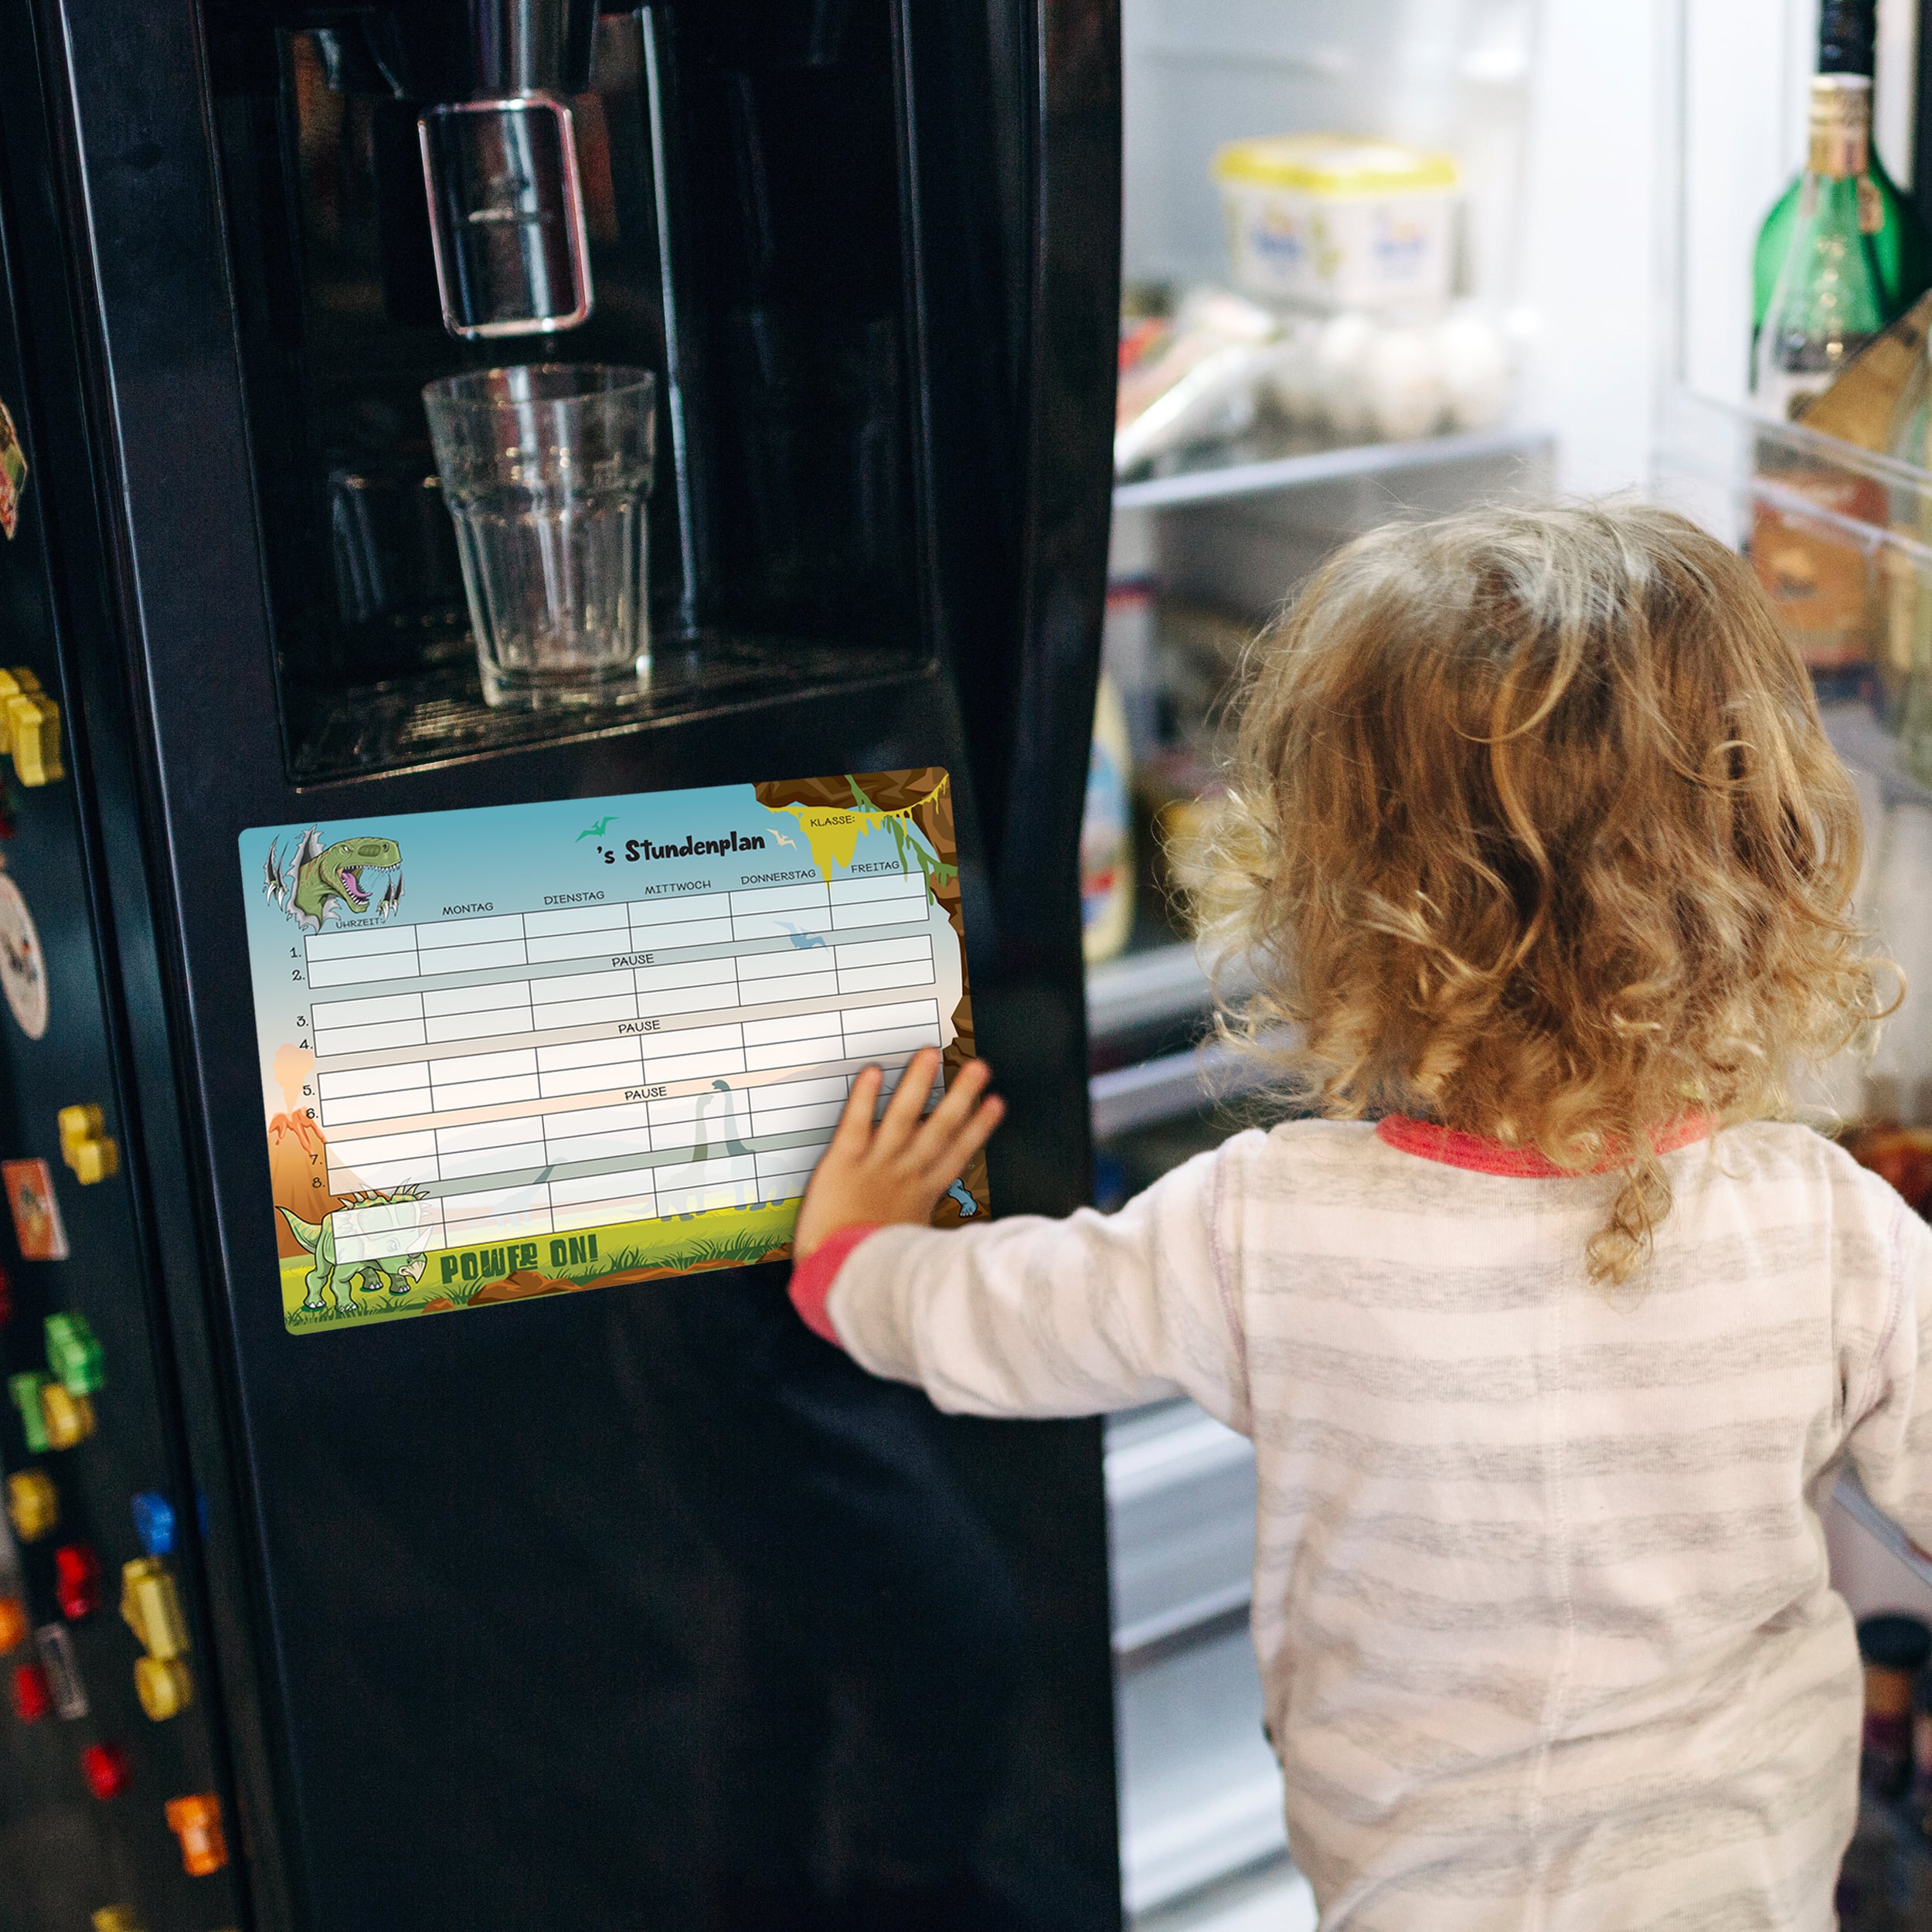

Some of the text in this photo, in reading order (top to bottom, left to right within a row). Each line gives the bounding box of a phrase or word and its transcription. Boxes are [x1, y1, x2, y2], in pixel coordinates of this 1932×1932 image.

[810, 815, 855, 828] KLASSE:
[624, 831, 765, 862] Stundenplan
[851, 861, 900, 873] FREITAG
[740, 869, 816, 884] DONNERSTAG
[645, 880, 712, 894] MITTWOCH
[544, 891, 604, 905] DIENSTAG
[442, 903, 494, 915] MONTAG
[289, 947, 302, 958] 1.
[611, 954, 655, 967] PAUSE
[291, 970, 305, 981] 2.
[296, 1015, 308, 1028] 3.
[618, 1020, 661, 1034] PAUSE
[299, 1039, 313, 1049] 4.
[303, 1084, 315, 1096] 5.
[624, 1087, 667, 1100] PAUSE
[305, 1107, 318, 1119] 6.
[311, 1154, 322, 1165] 7.
[311, 1177, 325, 1189] 8.
[440, 1234, 598, 1284] POWER ON!
